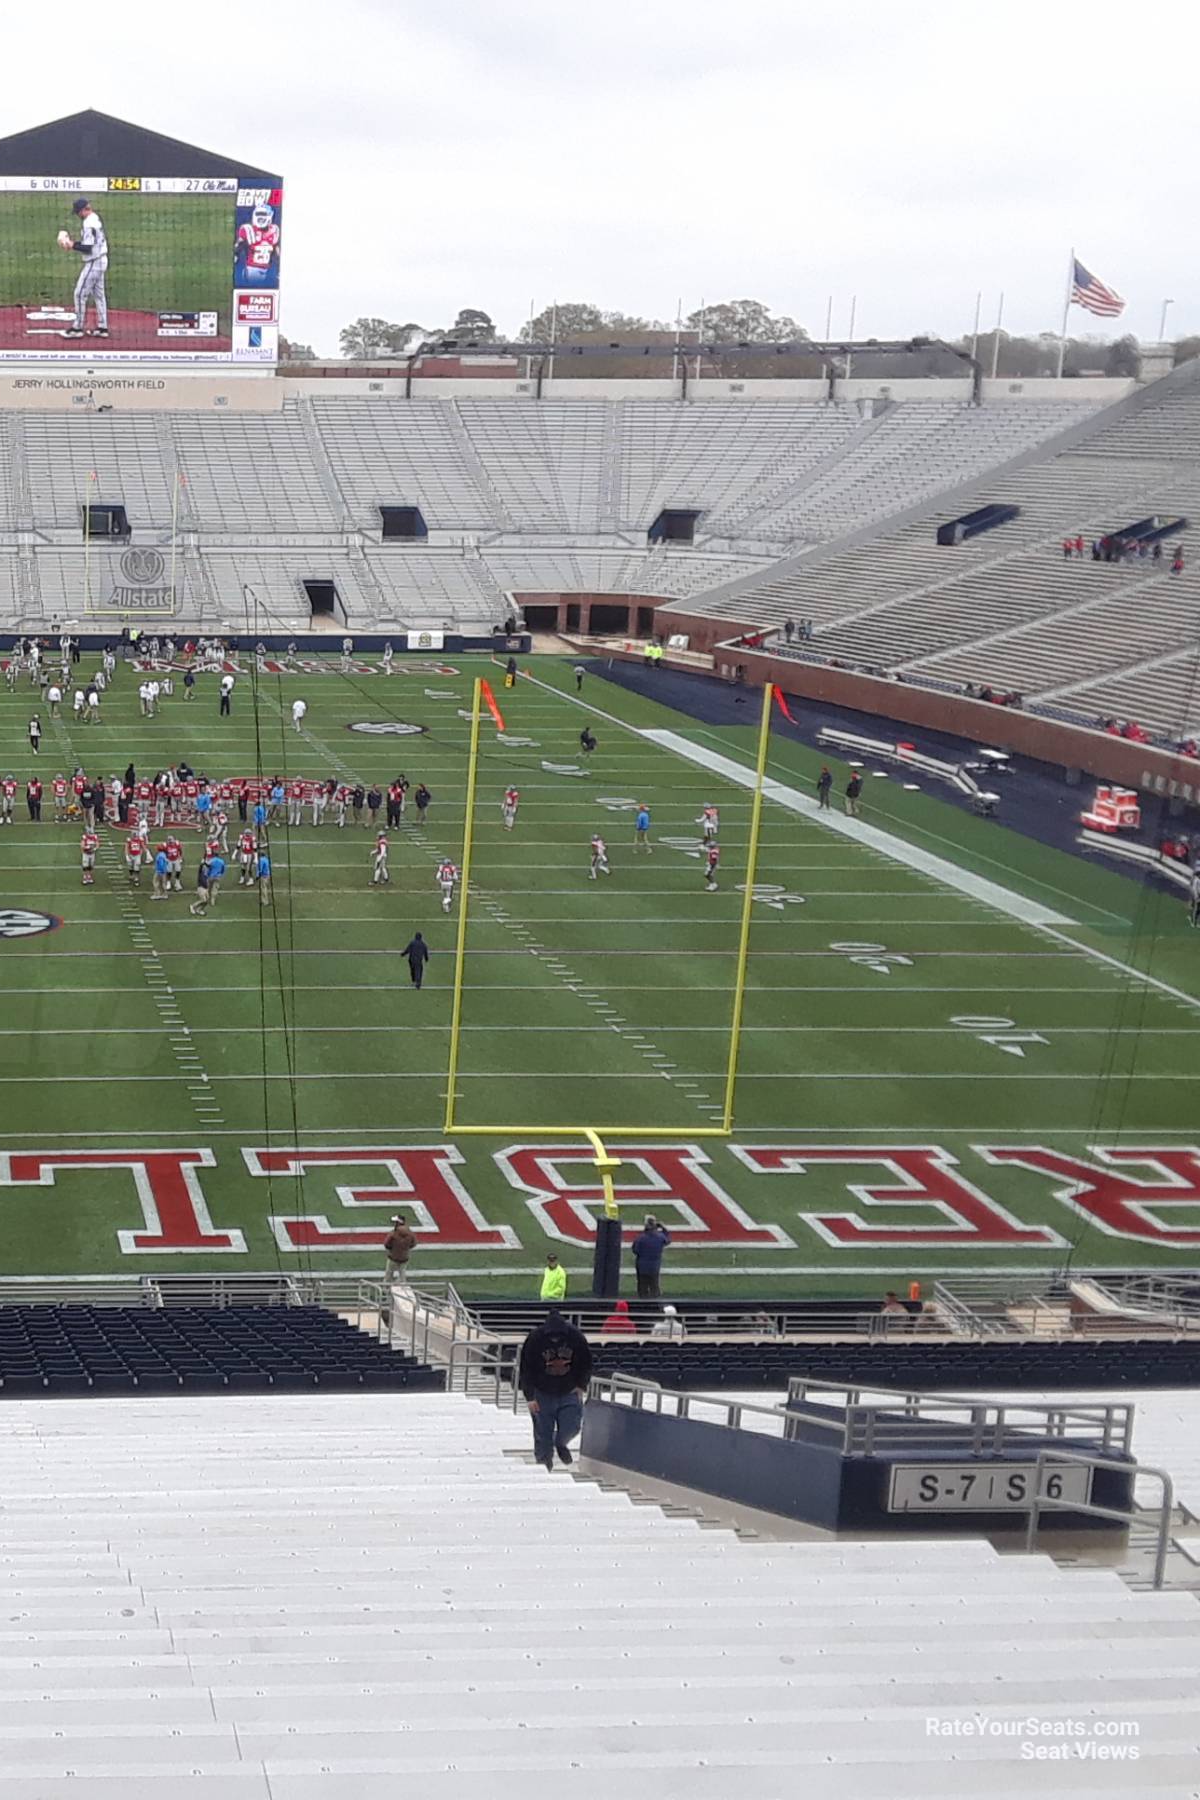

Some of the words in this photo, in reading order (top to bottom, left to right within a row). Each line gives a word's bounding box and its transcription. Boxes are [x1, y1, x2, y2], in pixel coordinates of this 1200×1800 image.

[43, 179, 58, 189] ON
[63, 179, 81, 189] THE
[186, 180, 199, 191] 27
[12, 379, 43, 389] JERRY
[46, 379, 134, 389] HOLLINGSWORTH
[137, 380, 165, 389] FIELD
[108, 586, 174, 607] Allstate
[918, 1474, 977, 1502] S-7
[1006, 1473, 1063, 1502] S6
